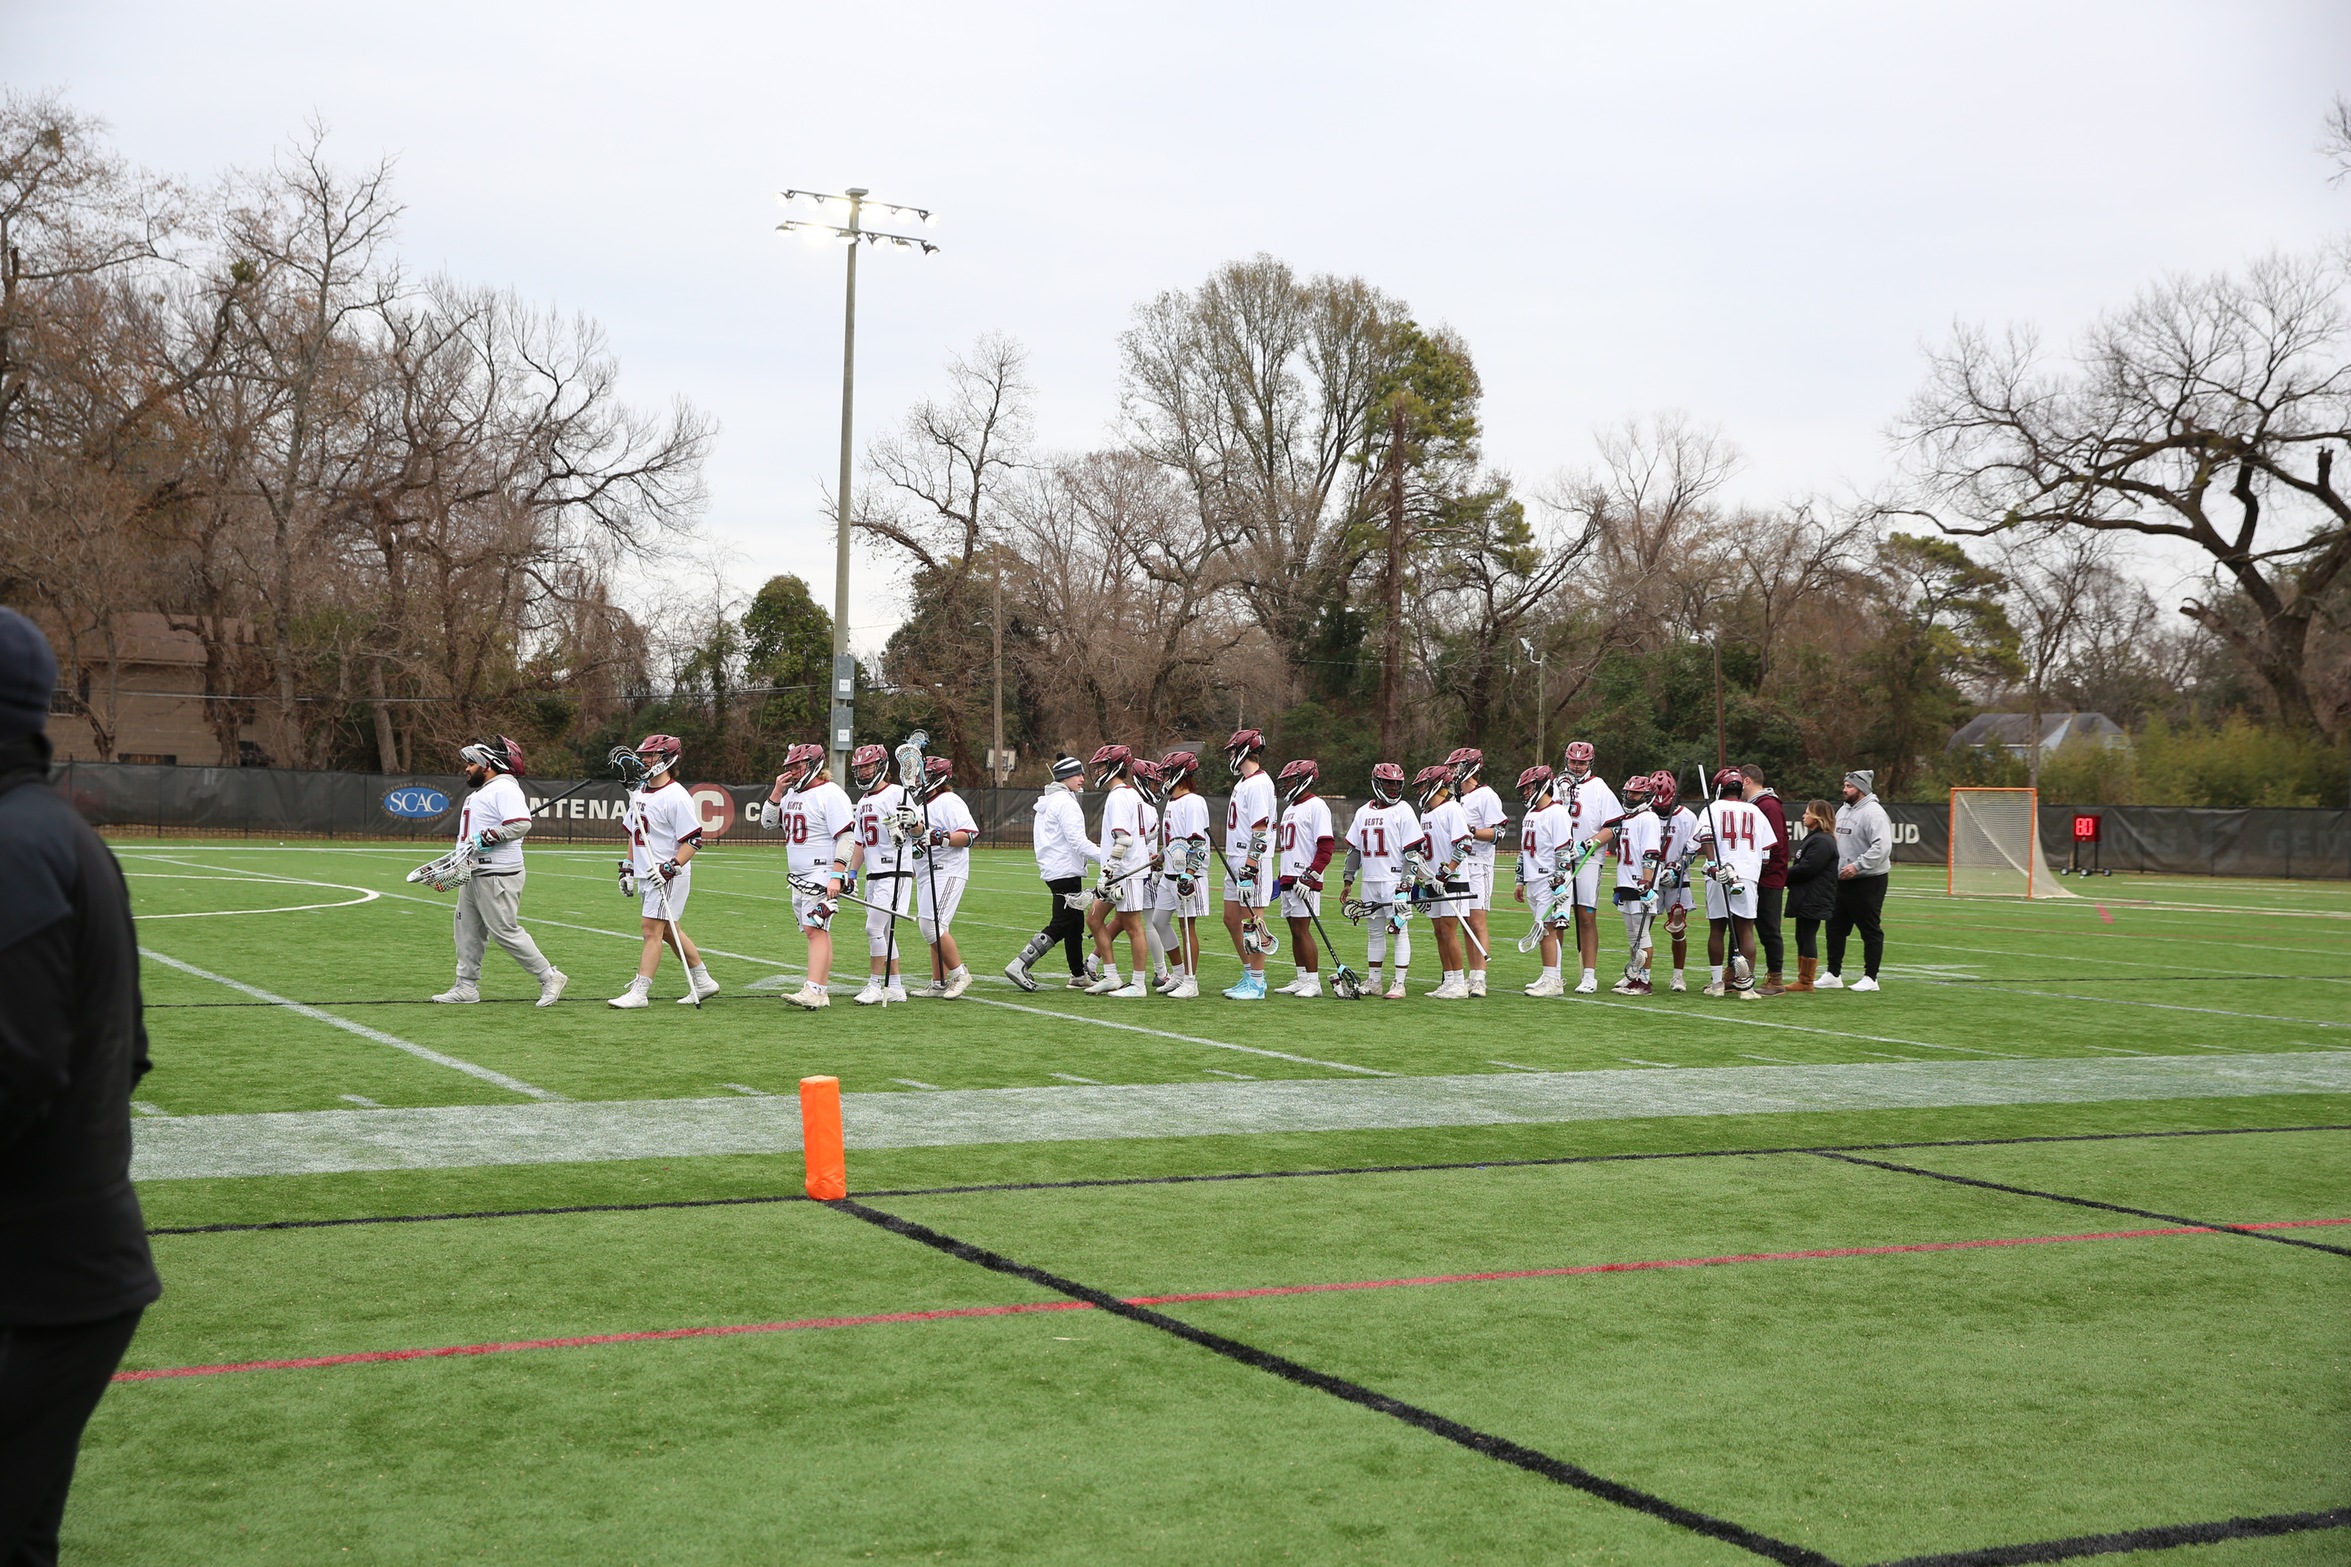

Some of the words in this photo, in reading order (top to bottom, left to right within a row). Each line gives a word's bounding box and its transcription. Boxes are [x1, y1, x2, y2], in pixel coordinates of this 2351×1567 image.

[389, 792, 443, 813] SCAC
[529, 797, 627, 820] NTENA
[864, 814, 879, 847] 5
[1721, 810, 1757, 851] 44
[2075, 817, 2094, 836] 80
[1360, 828, 1389, 858] 11
[1523, 830, 1537, 858] 4
